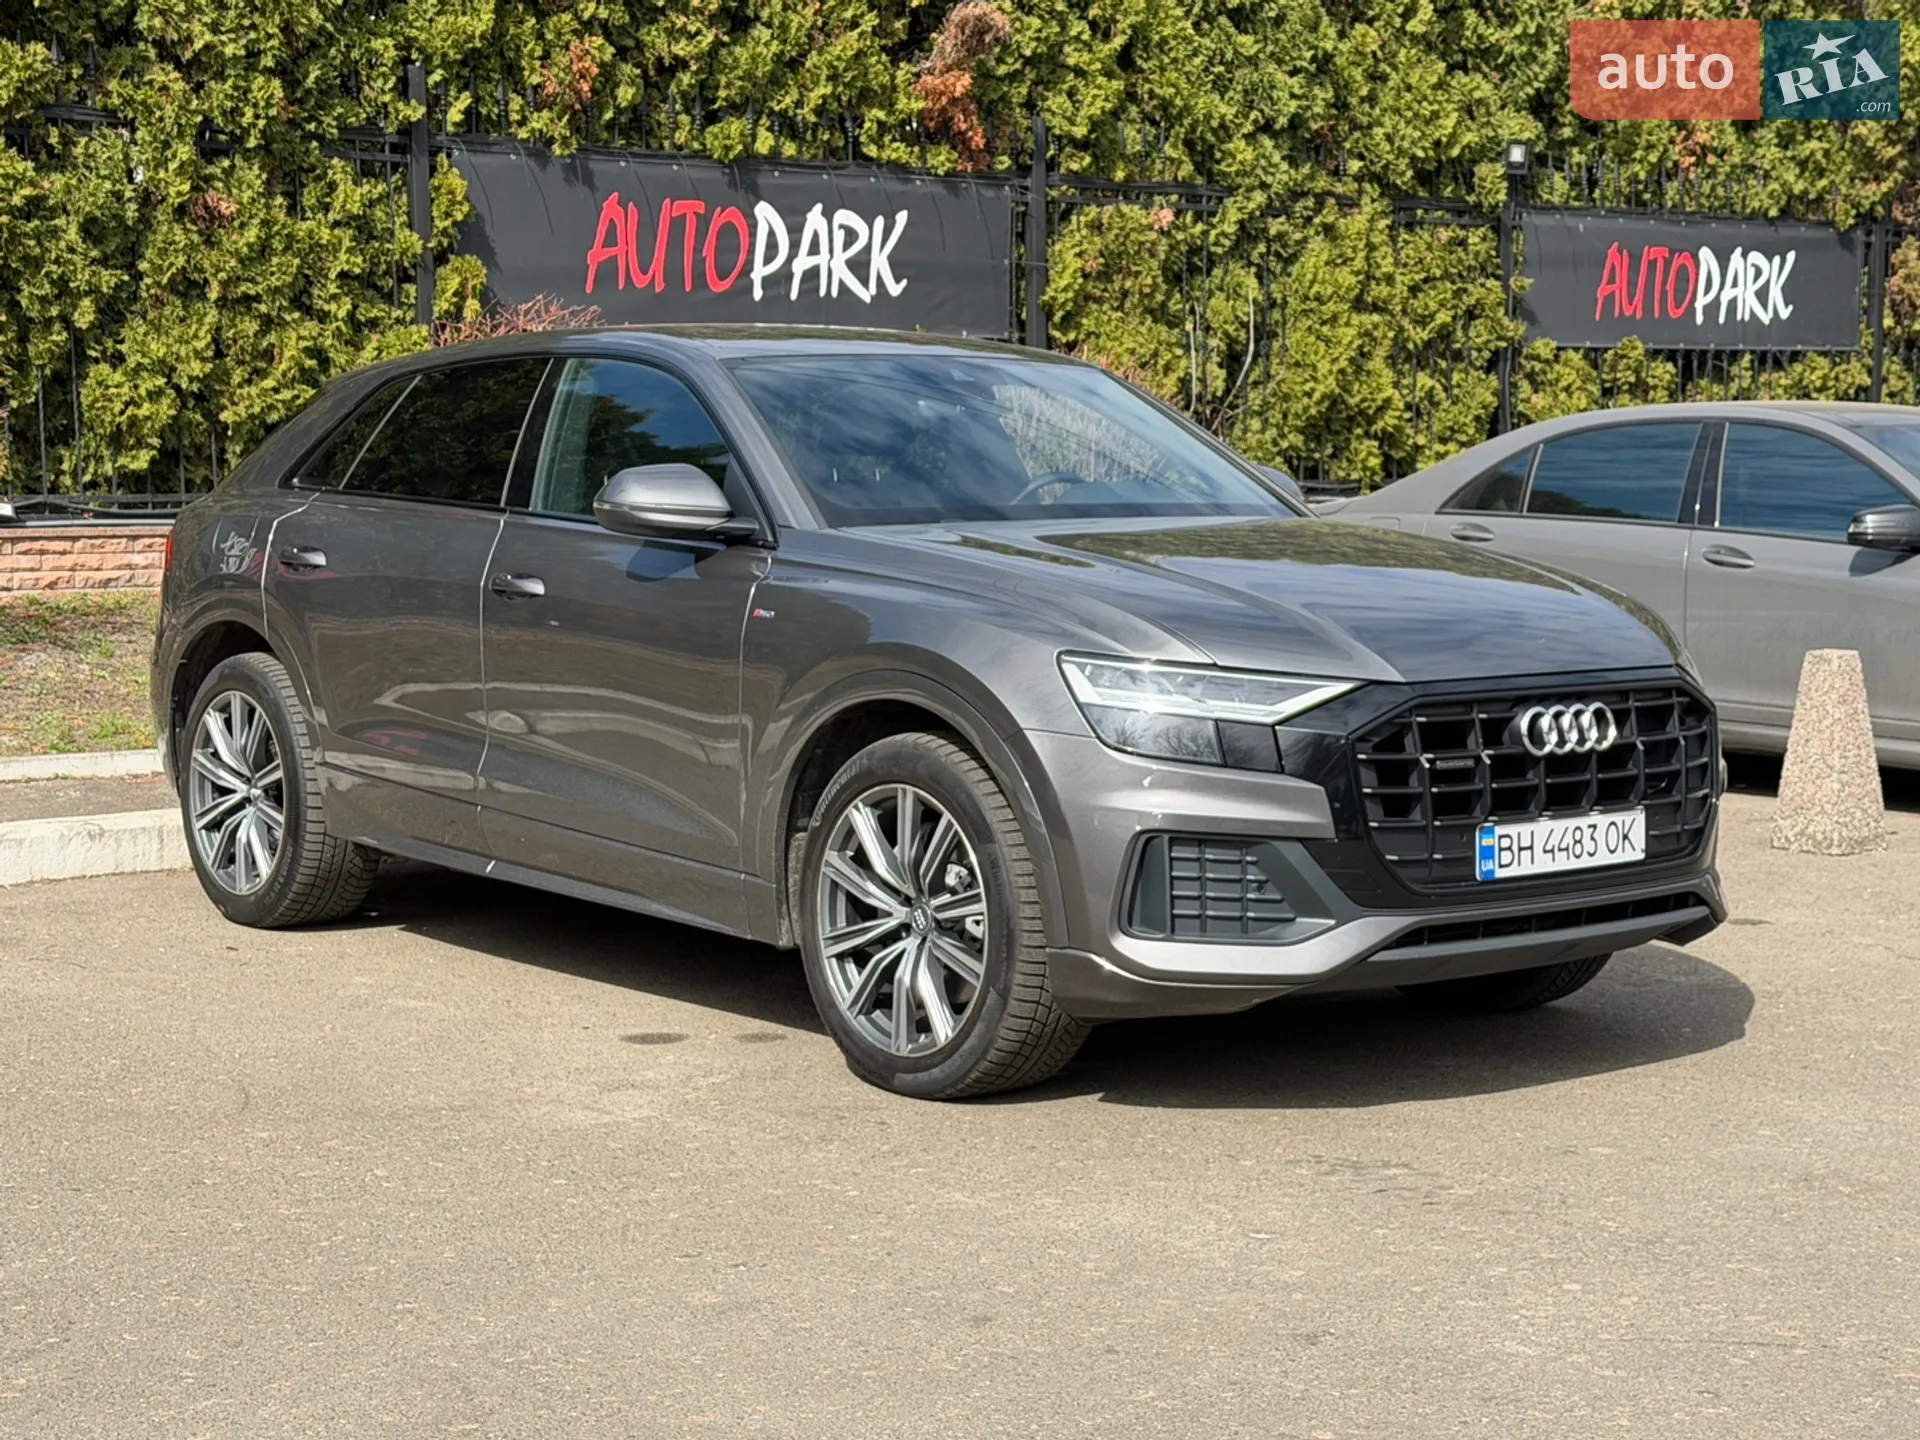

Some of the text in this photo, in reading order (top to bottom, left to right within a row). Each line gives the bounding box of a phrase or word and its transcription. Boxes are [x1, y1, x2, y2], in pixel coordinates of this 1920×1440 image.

[585, 190, 909, 304] AUTOPARK
[1595, 241, 1797, 327] AUTOPARK
[1480, 858, 1495, 872] UA
[1497, 816, 1638, 870] BH 4483 OK
